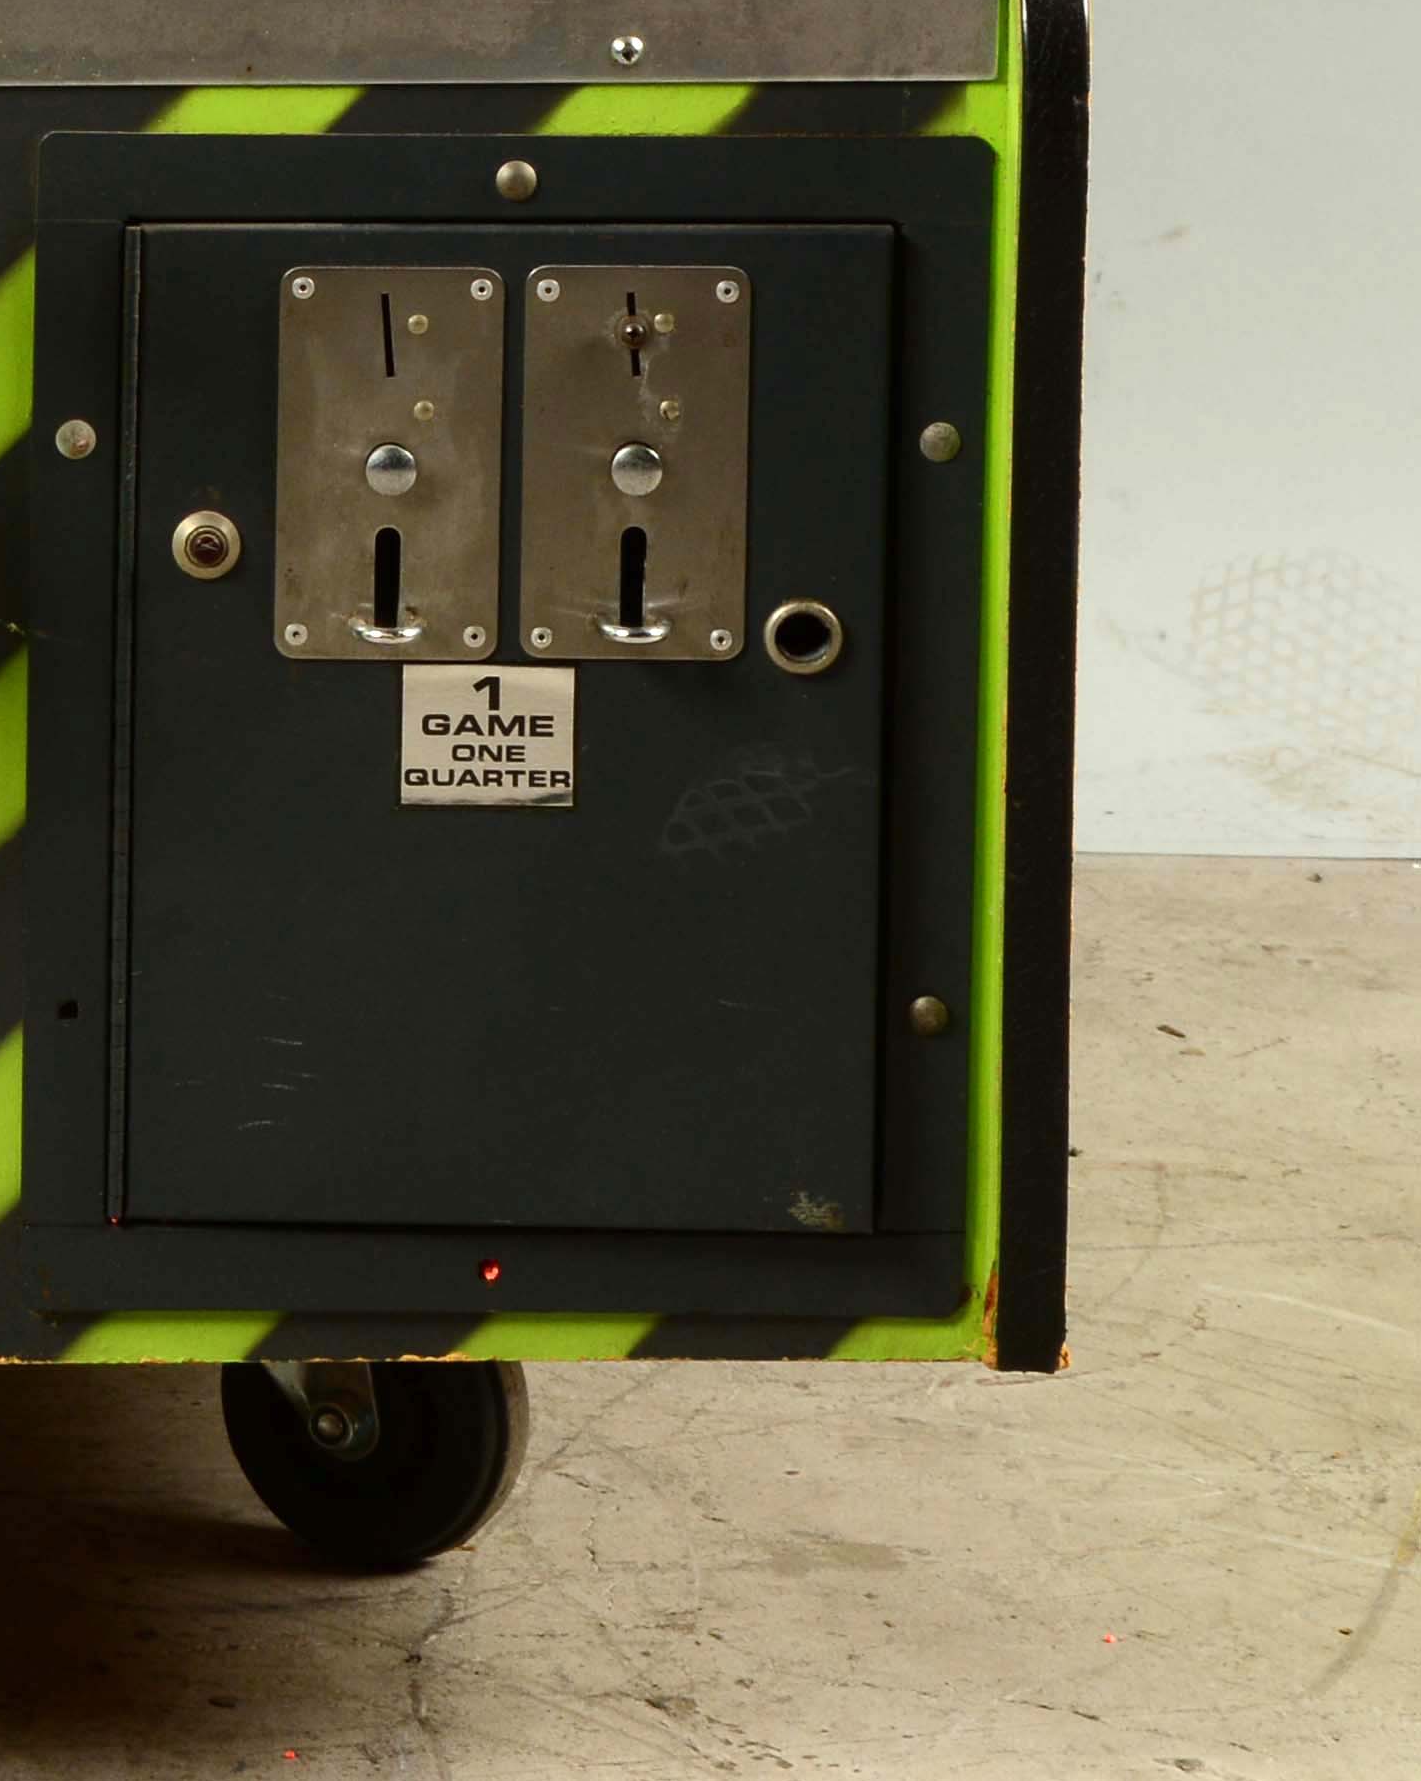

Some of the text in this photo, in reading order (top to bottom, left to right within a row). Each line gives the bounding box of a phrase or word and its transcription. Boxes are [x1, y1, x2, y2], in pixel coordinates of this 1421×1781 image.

[473, 676, 500, 711] 1
[422, 714, 554, 737] GAME
[451, 744, 526, 763] ONE
[404, 769, 571, 788] QUARTER
